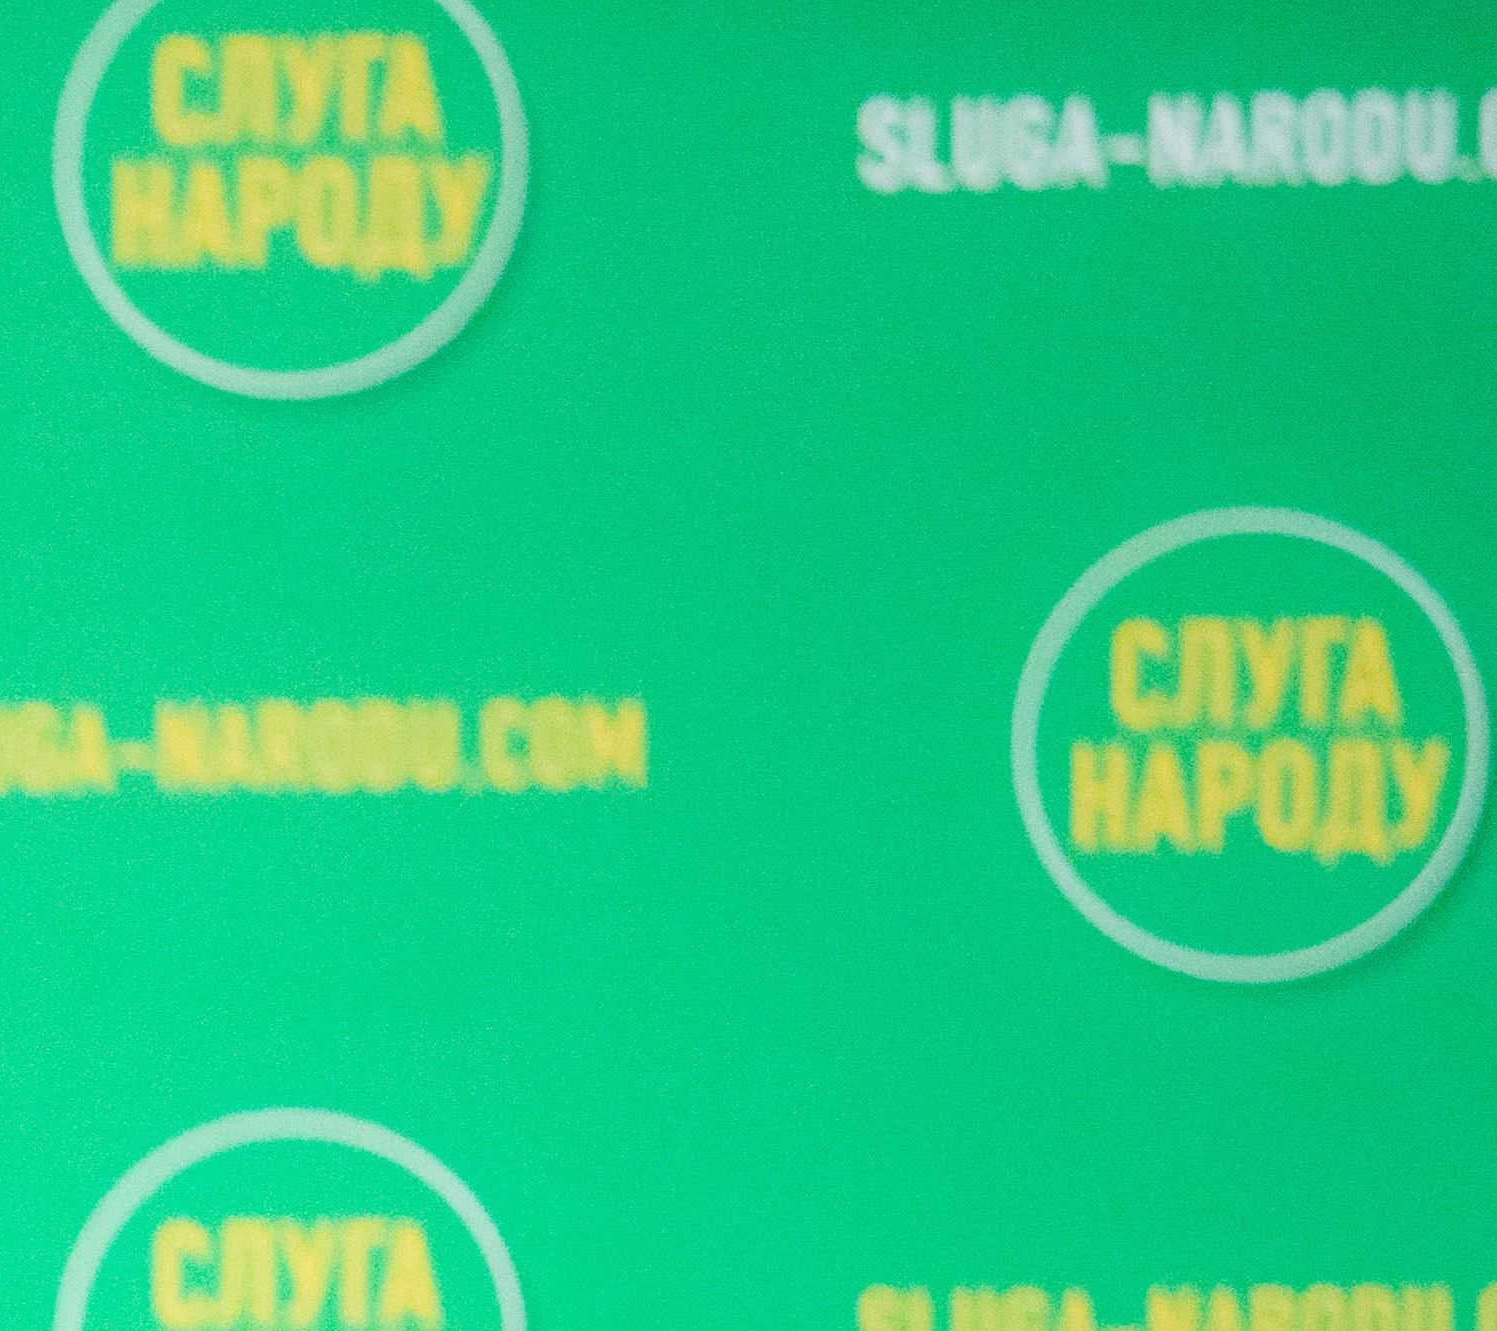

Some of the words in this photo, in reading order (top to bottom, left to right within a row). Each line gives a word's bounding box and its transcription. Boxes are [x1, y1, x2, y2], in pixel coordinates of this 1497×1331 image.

[152, 31, 443, 146] СЛУГА
[112, 148, 489, 278] НАРОДУ
[1111, 616, 1401, 730] СЛУГА
[1070, 732, 1447, 860] НАРОДУ
[149, 1216, 442, 1330] СЛУГА
